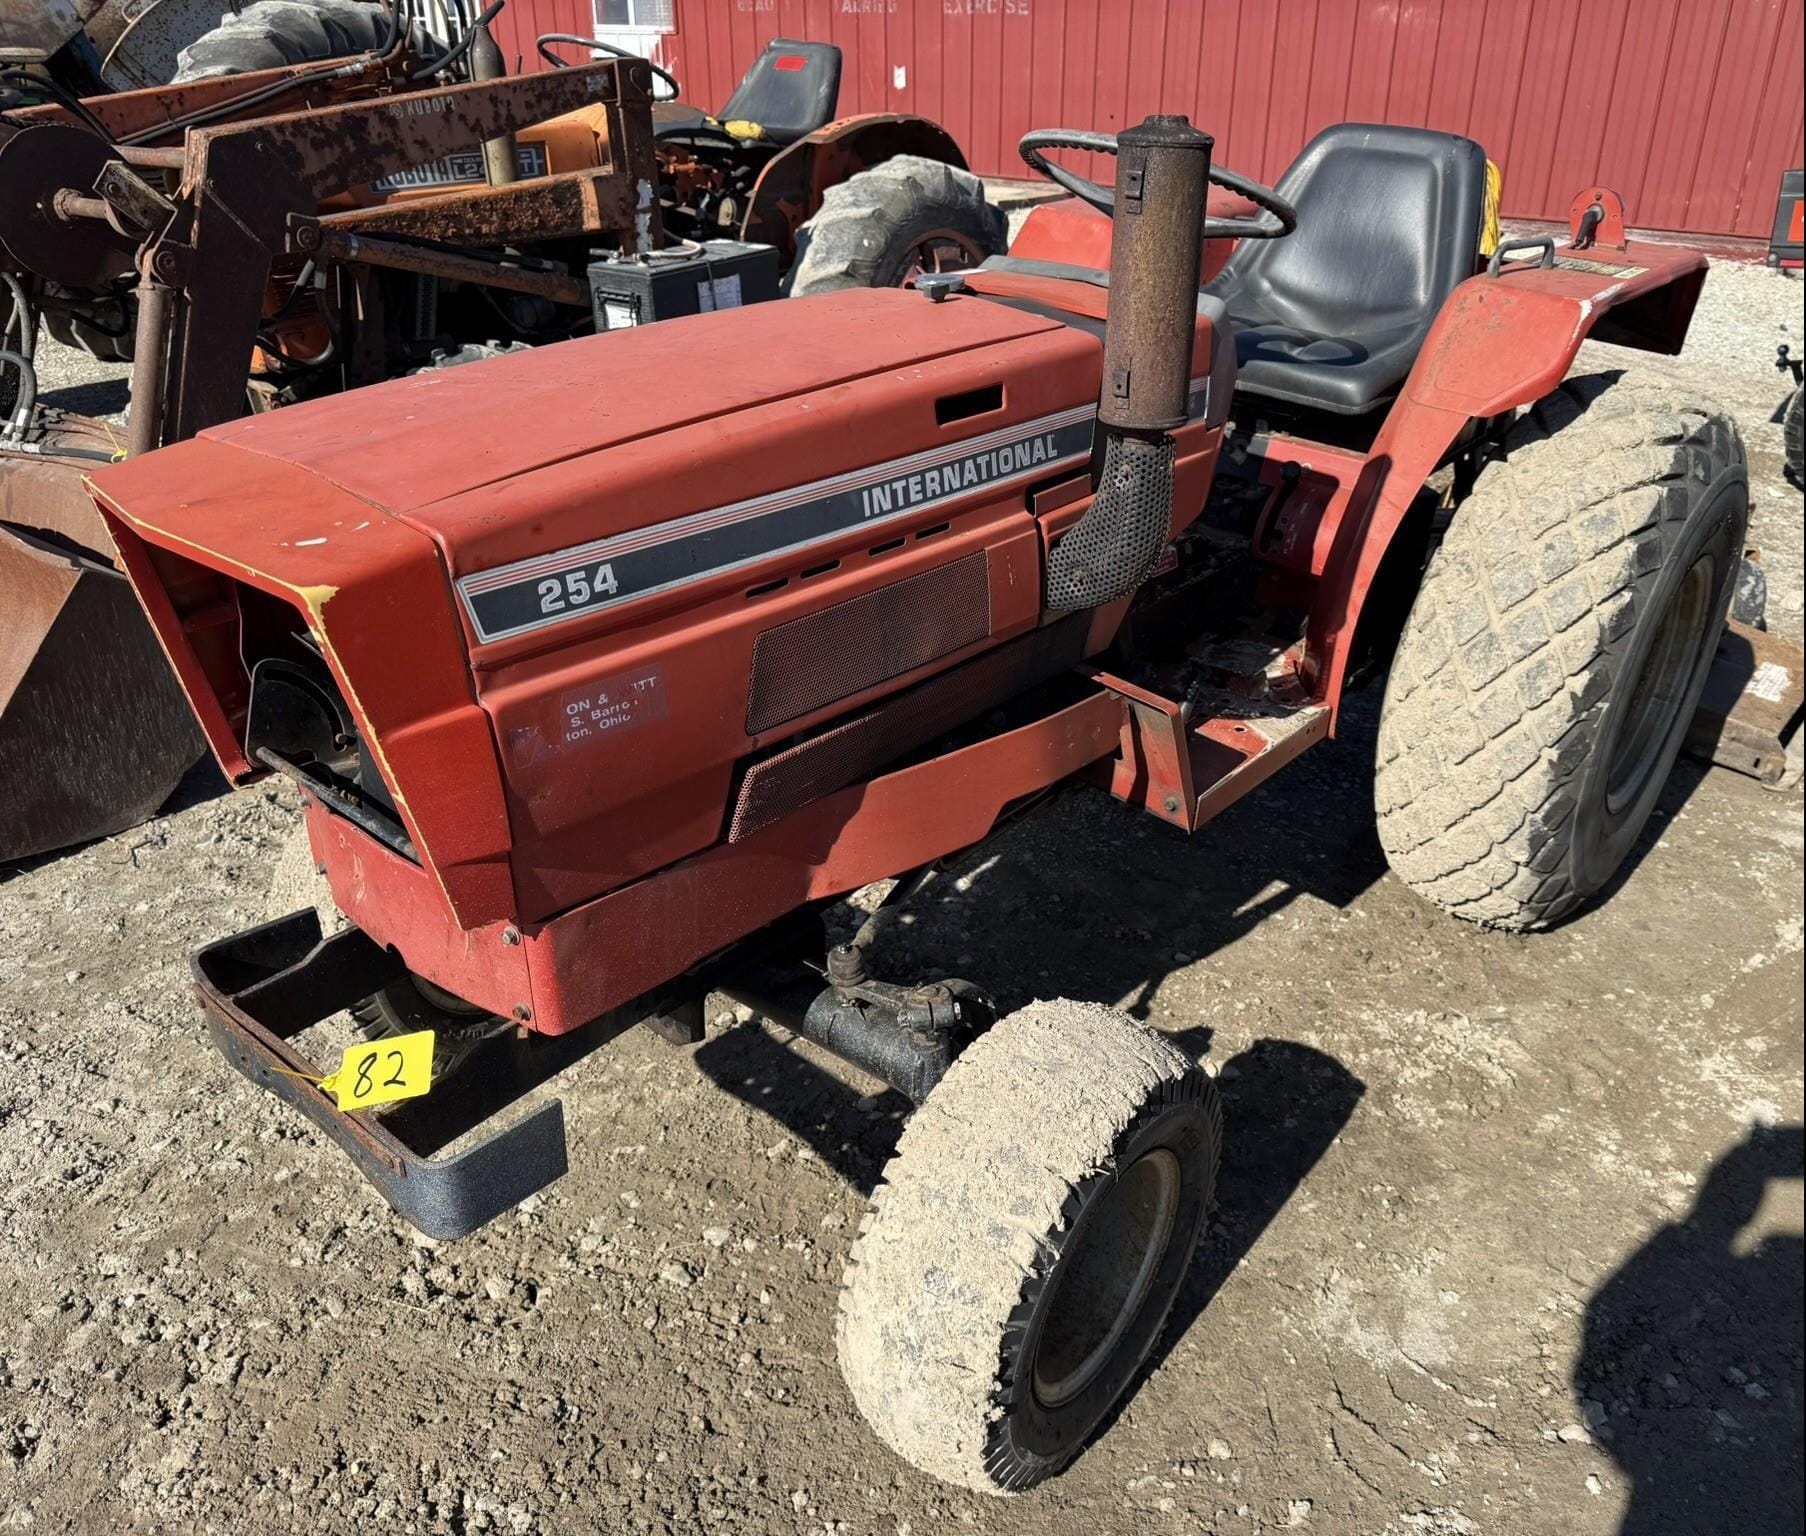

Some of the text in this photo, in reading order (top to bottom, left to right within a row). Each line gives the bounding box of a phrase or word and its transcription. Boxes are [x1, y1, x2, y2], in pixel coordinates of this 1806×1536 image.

[862, 434, 1058, 517] INTERNATIONAL
[538, 563, 618, 613] 254
[591, 699, 639, 721] Barro
[598, 693, 608, 705] &
[353, 1051, 407, 1098] 82
